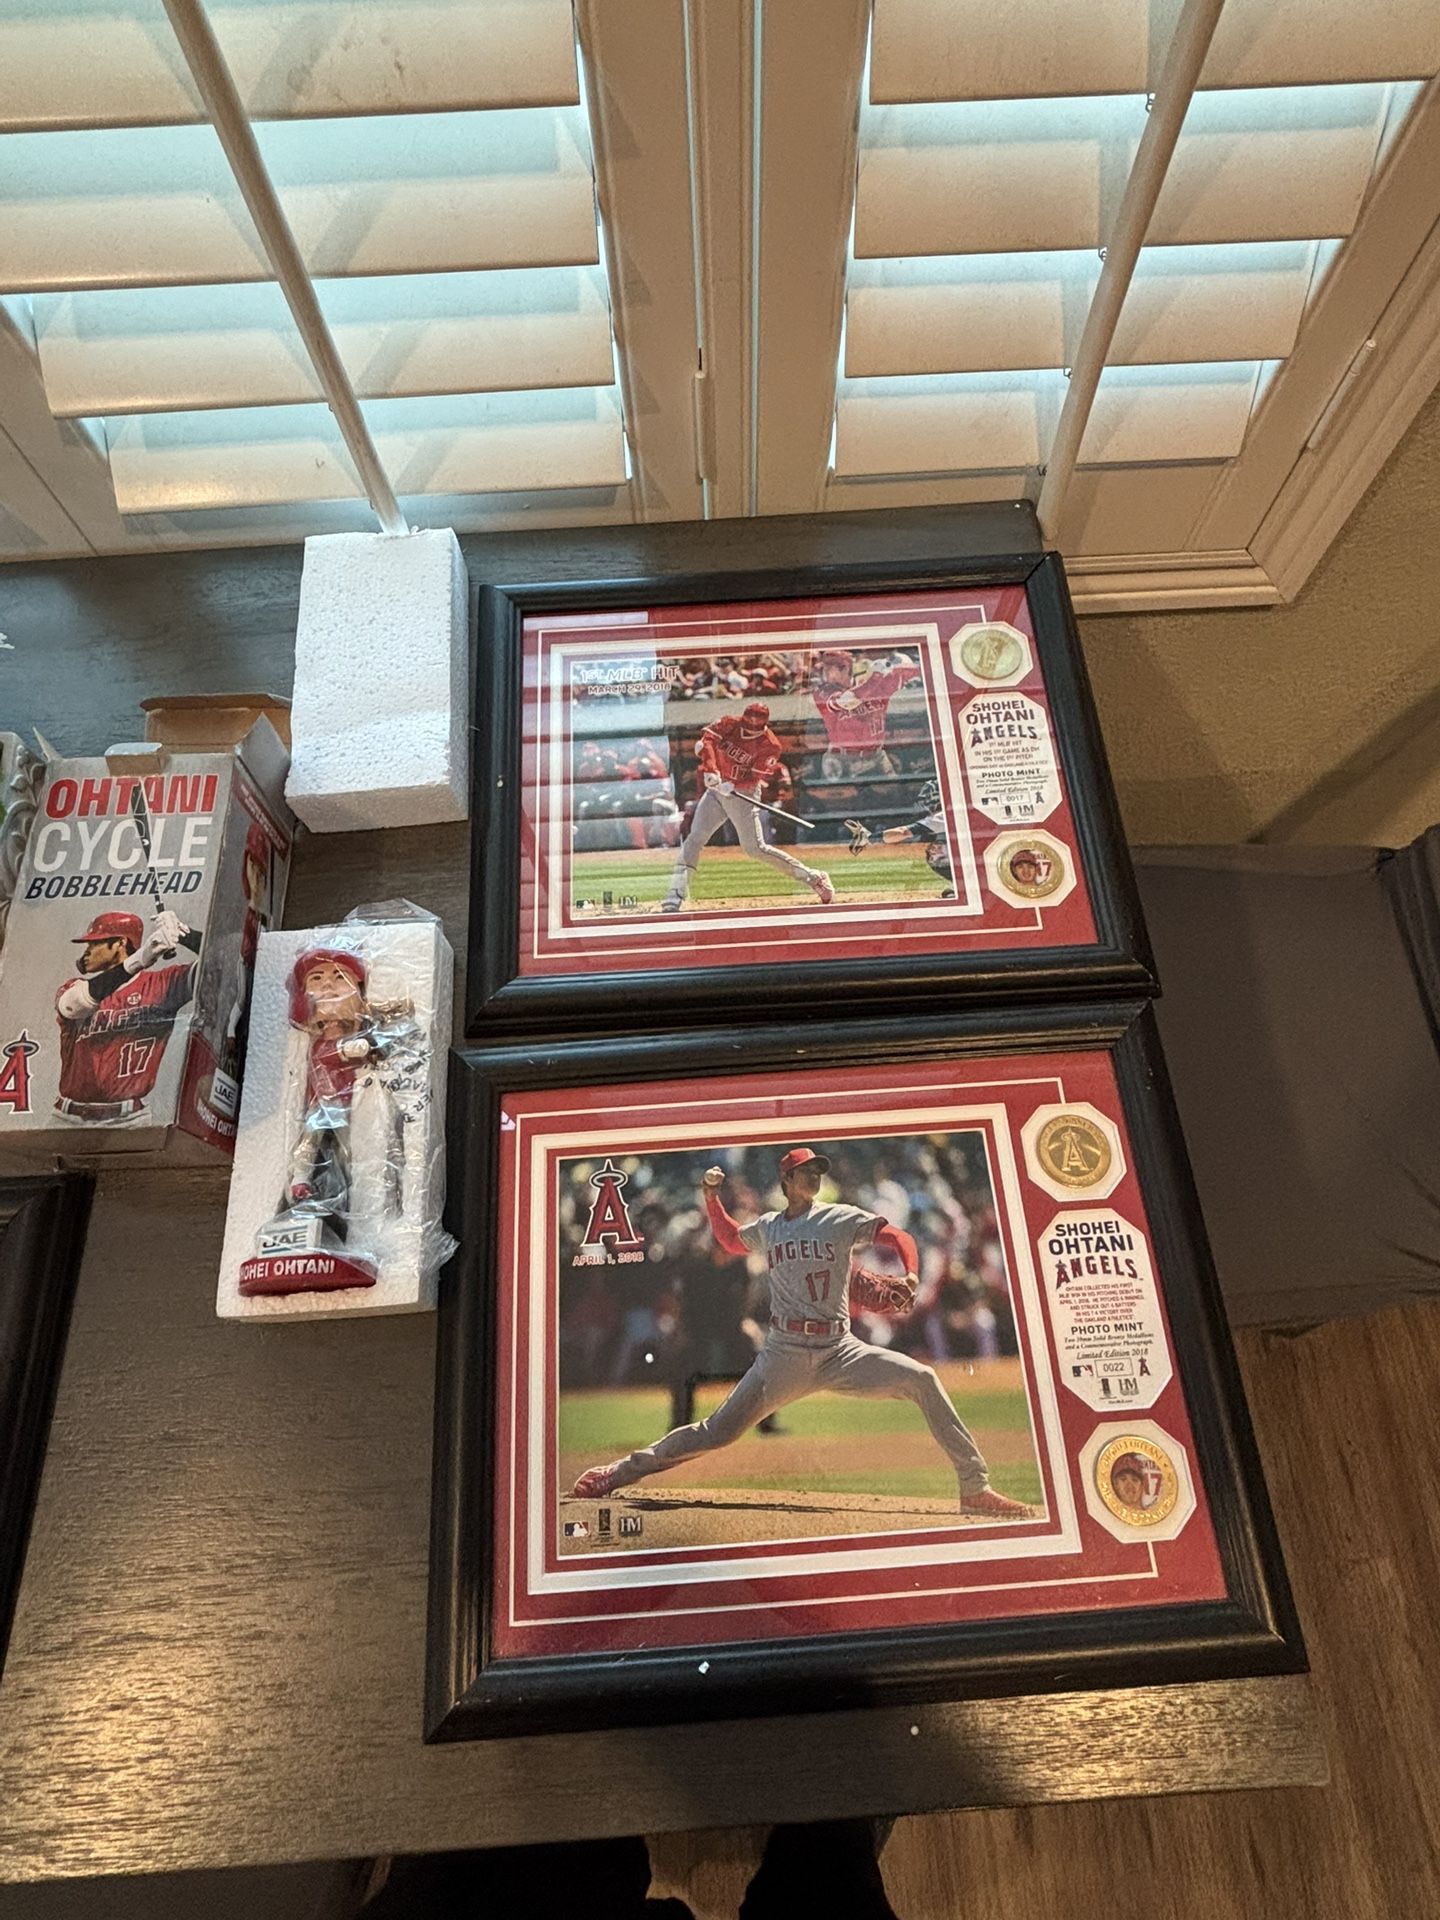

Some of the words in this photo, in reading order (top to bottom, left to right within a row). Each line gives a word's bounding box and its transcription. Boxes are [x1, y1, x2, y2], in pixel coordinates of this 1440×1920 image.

[651, 665, 679, 680] HIT
[588, 685, 626, 695] MARCH
[646, 682, 672, 692] 2018
[972, 700, 1025, 712] SHOHEI
[966, 709, 1035, 725] OHTANI
[971, 725, 1038, 748] ANGELS
[982, 771, 1014, 779] PHOTO
[1016, 768, 1041, 776] MINT
[45, 773, 219, 820] OHTANI
[33, 817, 214, 873] CYCLE
[24, 871, 203, 901] BOBBLEHEAD
[117, 1036, 156, 1078] 17
[215, 1085, 235, 1101] JAE
[1055, 1220, 1120, 1237] SHOHEI
[262, 1231, 307, 1248] JAE
[1048, 1234, 1134, 1256] OHTANI
[572, 1255, 605, 1267] APRIL
[617, 1251, 645, 1263] 2018
[768, 1239, 836, 1270] ANGELS
[273, 1259, 336, 1277] OHTANI
[1055, 1255, 1138, 1289] ANGELS
[805, 1269, 831, 1302] 17
[1071, 1324, 1110, 1335] PHOTO
[1114, 1322, 1143, 1332] MINT
[1076, 1350, 1103, 1360] Limited
[1104, 1349, 1130, 1358] Edition
[1131, 1348, 1149, 1356] 2018
[1103, 1362, 1125, 1373] 0022
